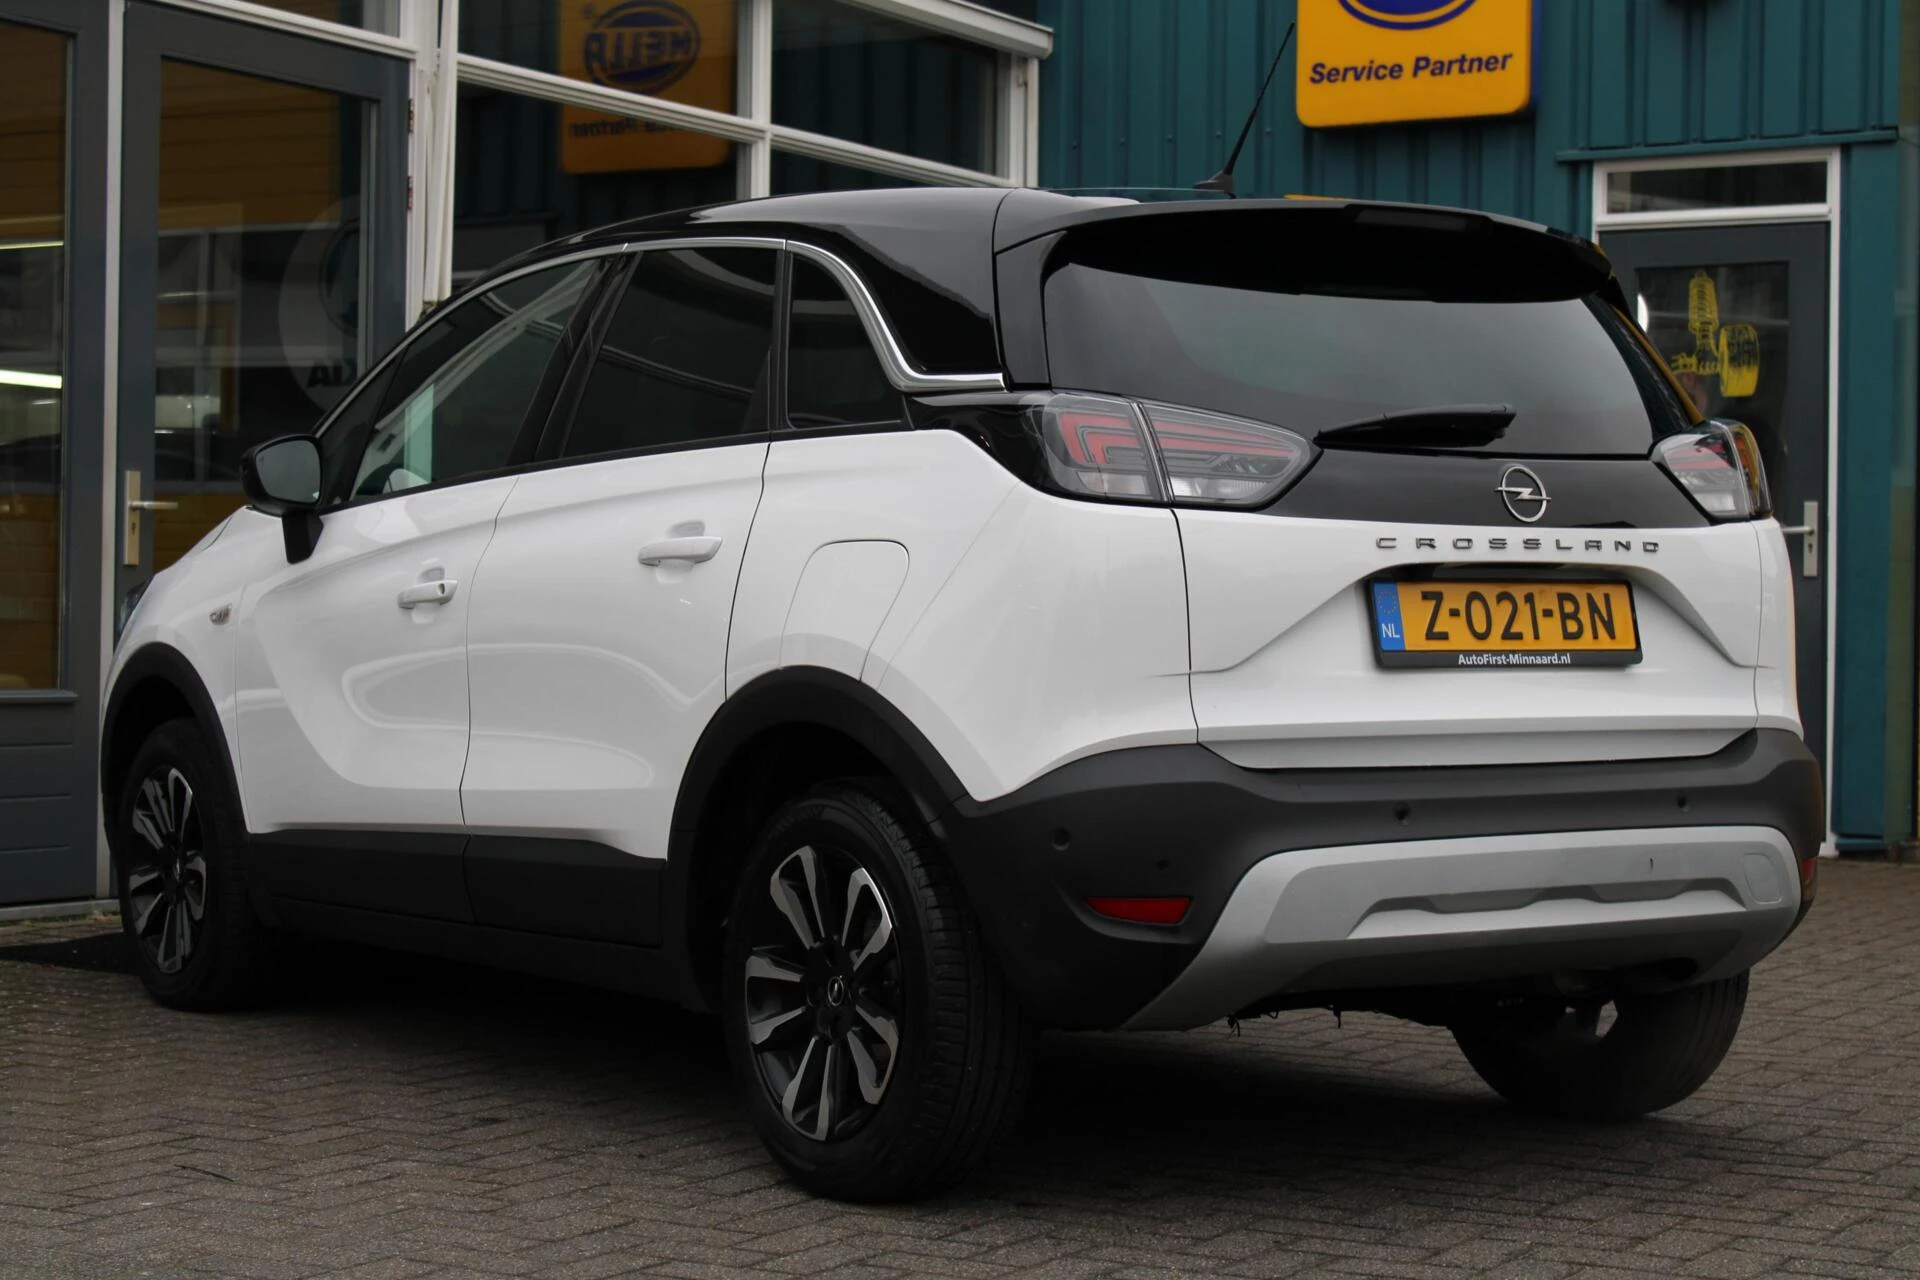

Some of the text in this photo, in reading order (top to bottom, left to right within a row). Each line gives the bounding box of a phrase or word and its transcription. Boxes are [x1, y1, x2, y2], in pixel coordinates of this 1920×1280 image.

[1309, 53, 1513, 84] Service Partner
[1376, 537, 1660, 553] CROSSLAND
[1381, 590, 1617, 641] NL Z-021-BN
[1457, 653, 1572, 667] AutoFirst-Minnaard.nl
